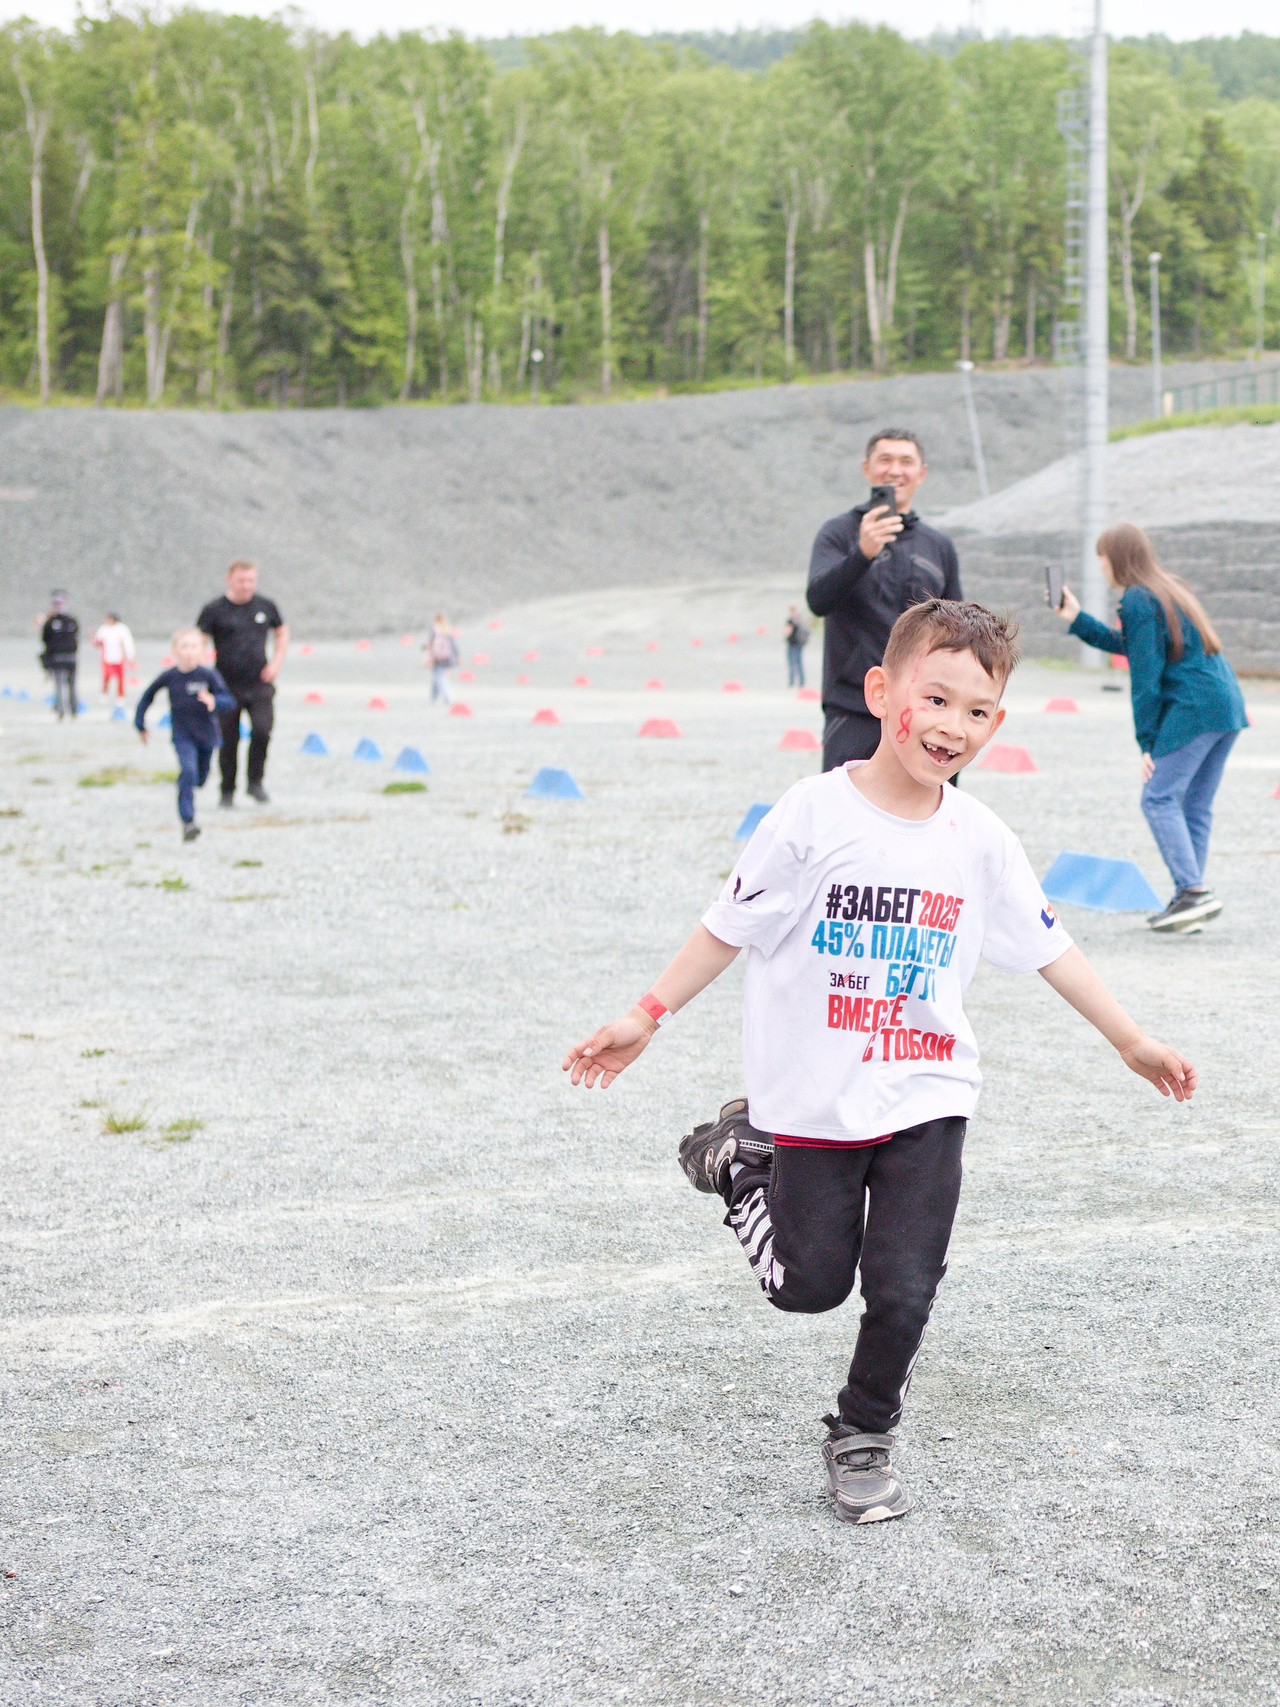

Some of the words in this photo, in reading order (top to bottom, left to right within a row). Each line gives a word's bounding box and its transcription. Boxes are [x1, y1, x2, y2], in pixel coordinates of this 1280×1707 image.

[811, 920, 865, 958] 45%
[870, 924, 957, 968] ПЛАНЕТЫ
[880, 1028, 957, 1062] ТОБОЙ
